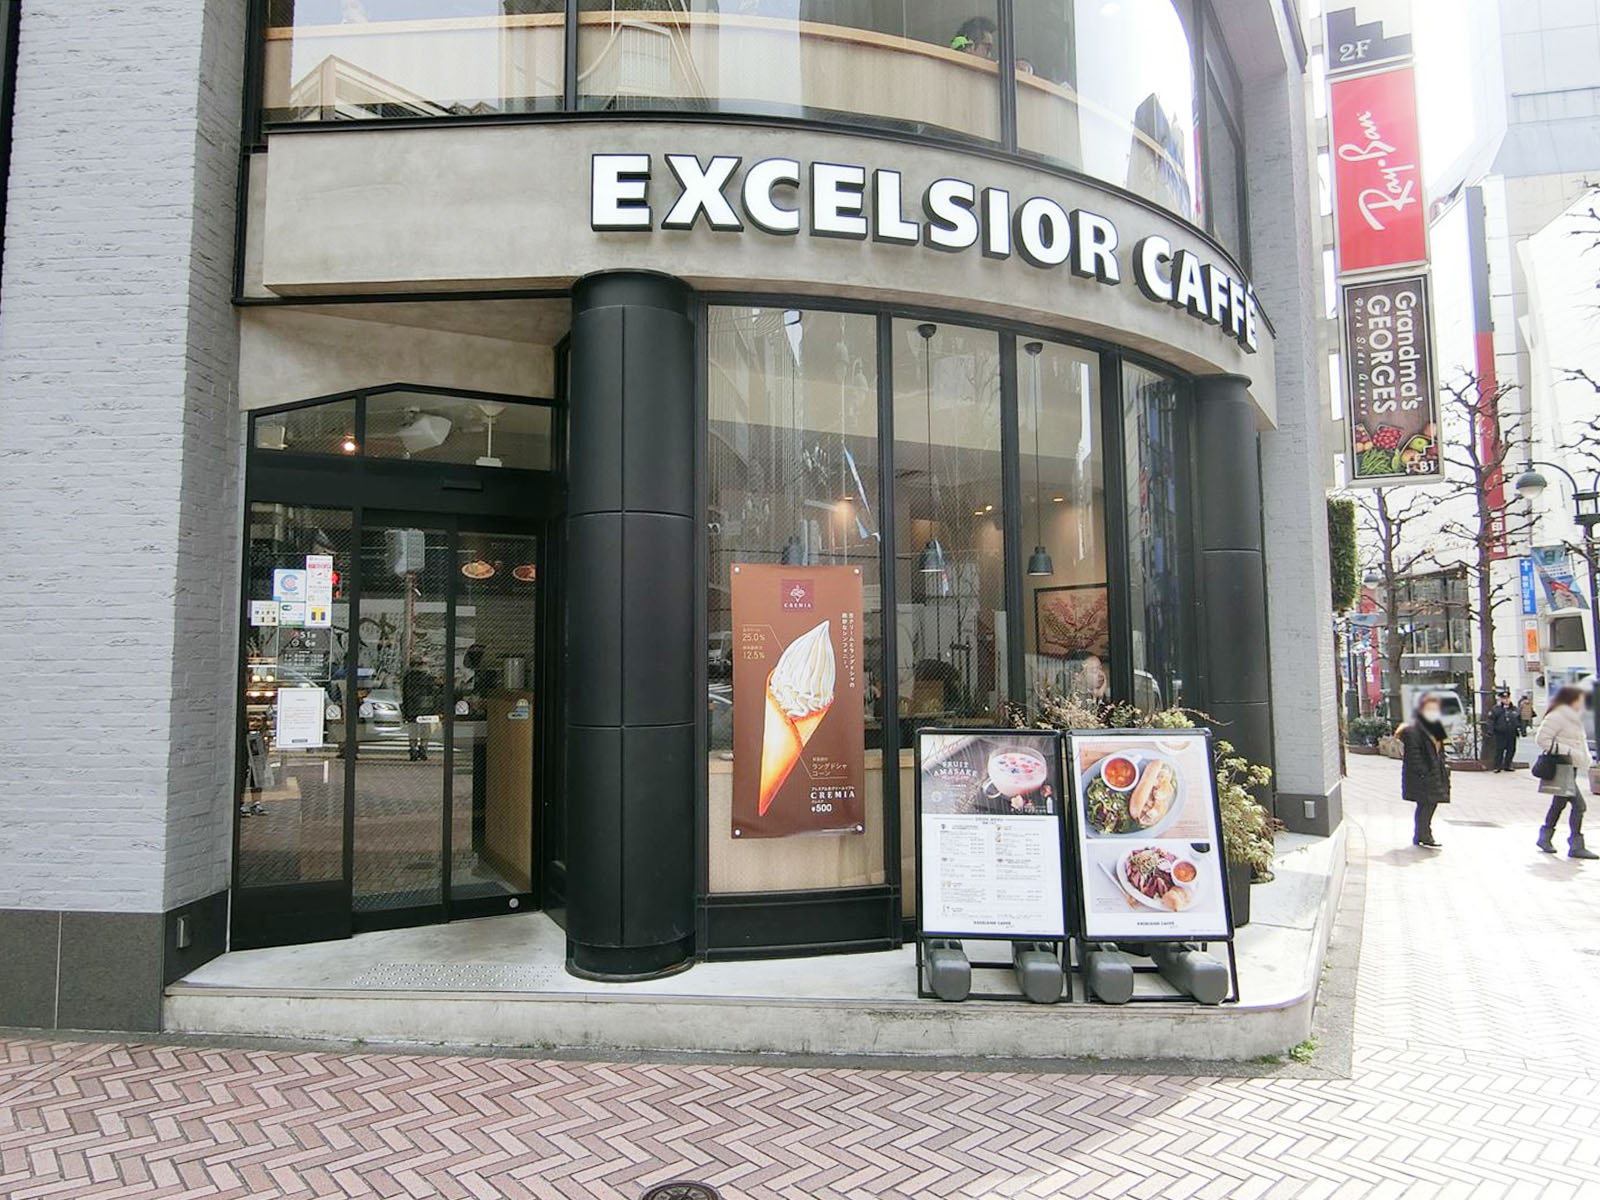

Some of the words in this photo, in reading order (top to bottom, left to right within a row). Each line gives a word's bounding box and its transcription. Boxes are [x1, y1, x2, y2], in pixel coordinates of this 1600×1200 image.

[1340, 39, 1371, 61] 2F
[591, 153, 1120, 285] EXCELSIOR
[1367, 294, 1397, 414] GEORGES
[1394, 291, 1423, 411] Grandma's
[1419, 460, 1435, 473] B1
[742, 632, 766, 642] 25.0%
[810, 790, 855, 799] CREMIA
